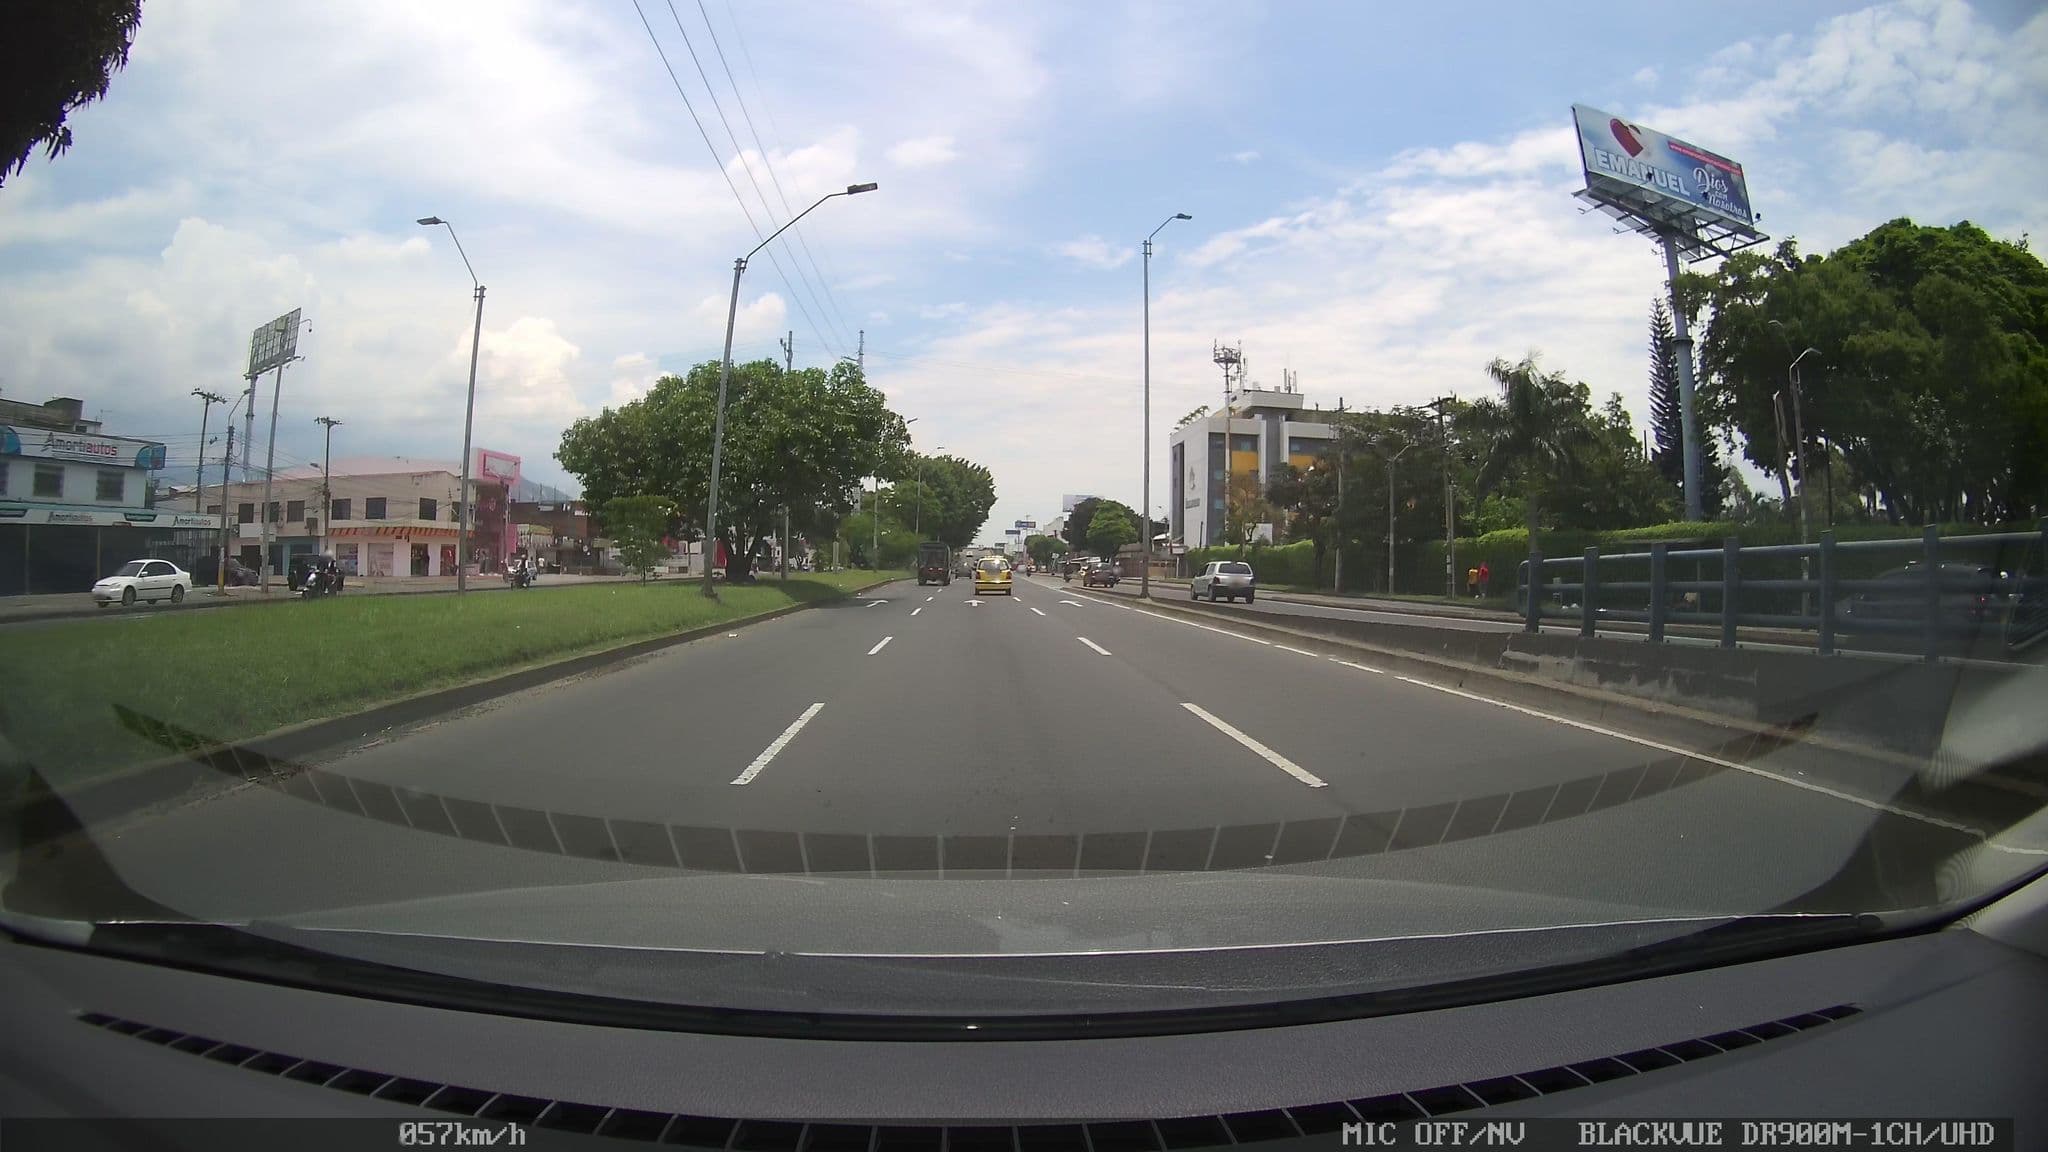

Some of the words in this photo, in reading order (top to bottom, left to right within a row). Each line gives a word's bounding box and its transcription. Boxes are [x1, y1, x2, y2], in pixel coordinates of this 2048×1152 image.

[1594, 147, 1690, 197] EMANUEL
[1693, 167, 1728, 194] Dios
[41, 431, 118, 456] Amortiautos
